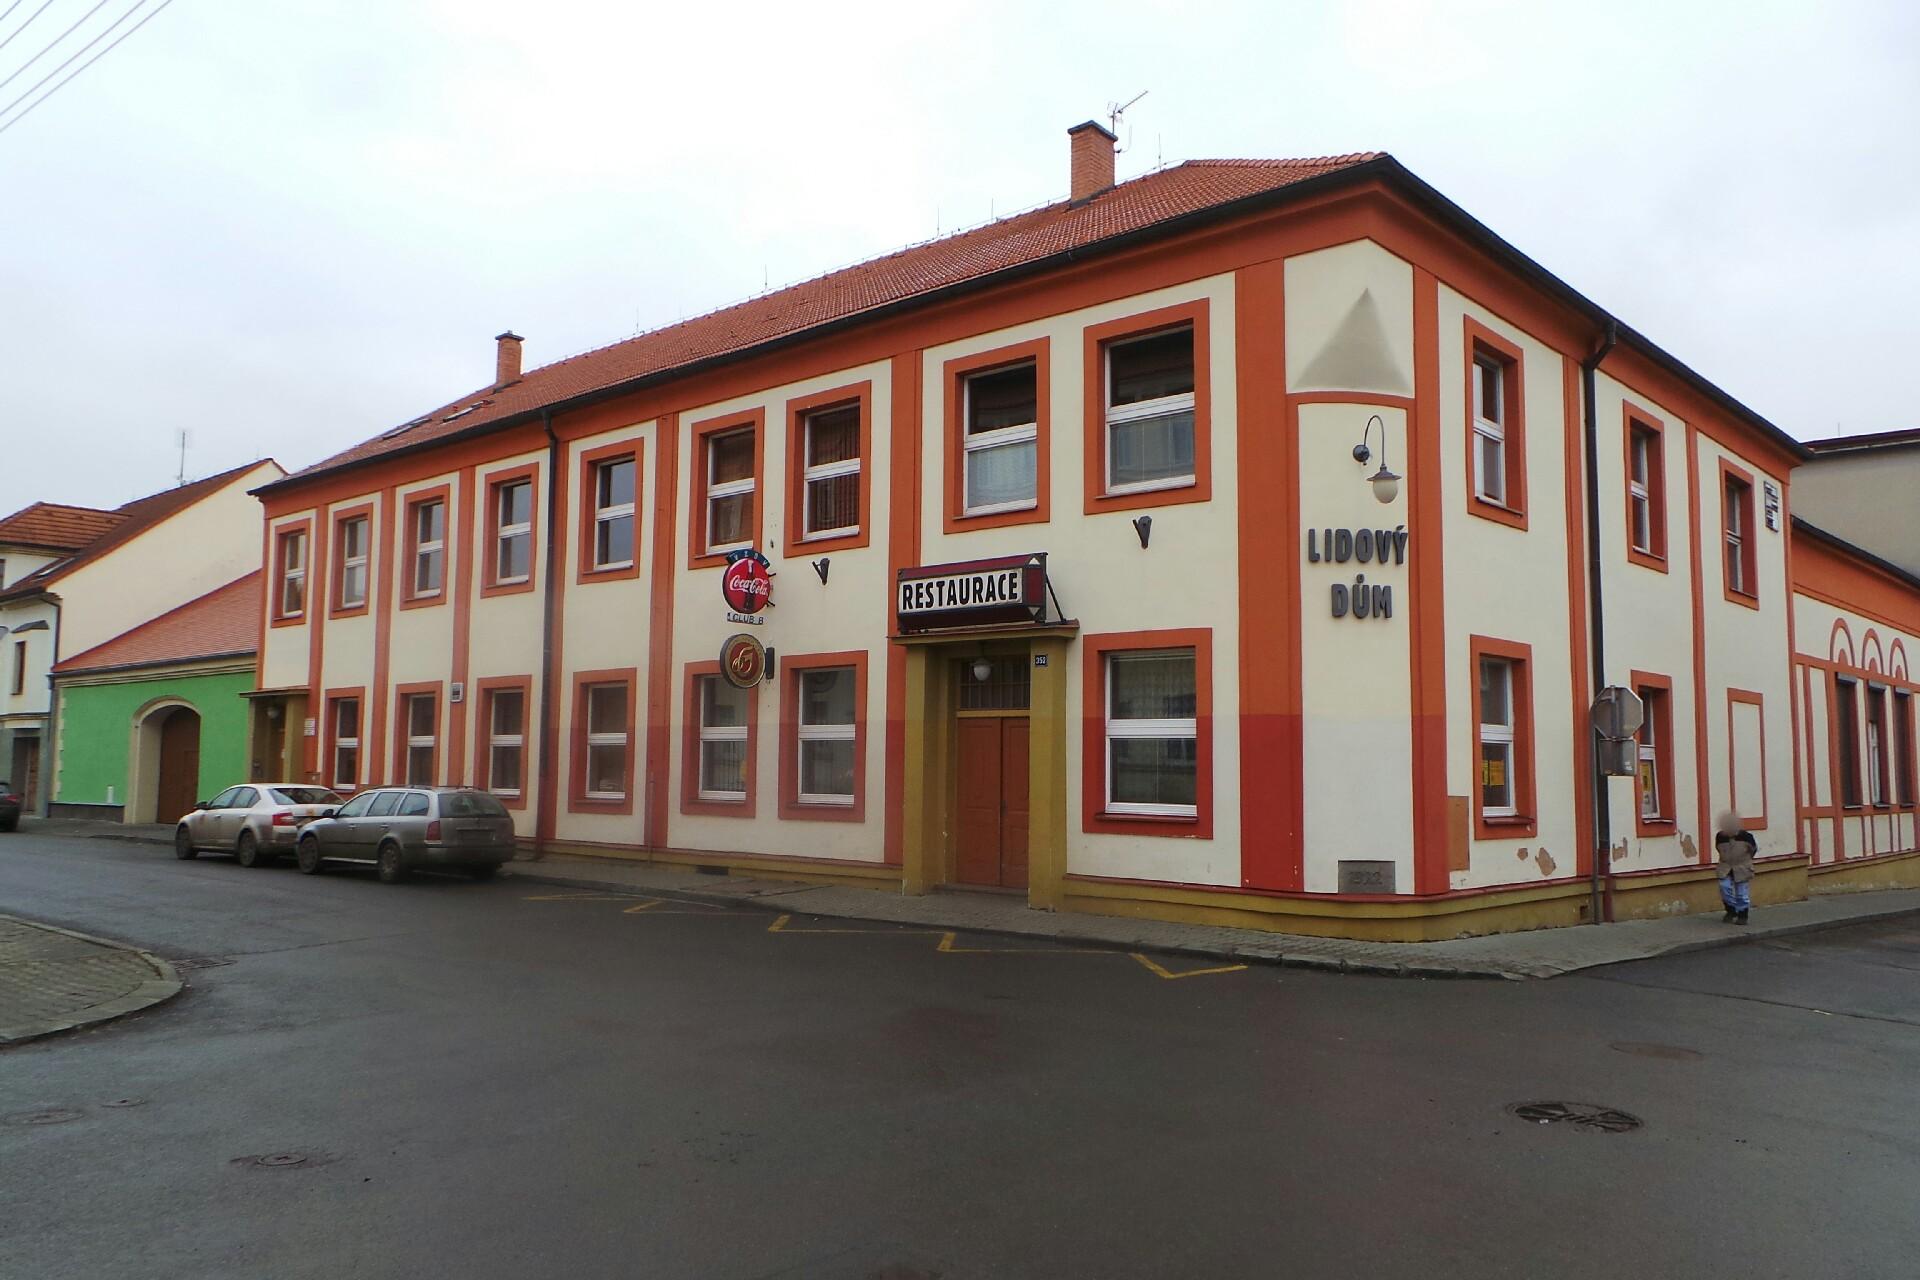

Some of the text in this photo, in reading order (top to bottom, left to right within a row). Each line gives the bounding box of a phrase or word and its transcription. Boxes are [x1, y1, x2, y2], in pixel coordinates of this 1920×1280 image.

[1308, 525, 1408, 565] LIDOVÝ
[730, 575, 769, 597] Coca-Cola
[902, 573, 1018, 610] RESTAURACE
[1331, 574, 1392, 619] DŮM
